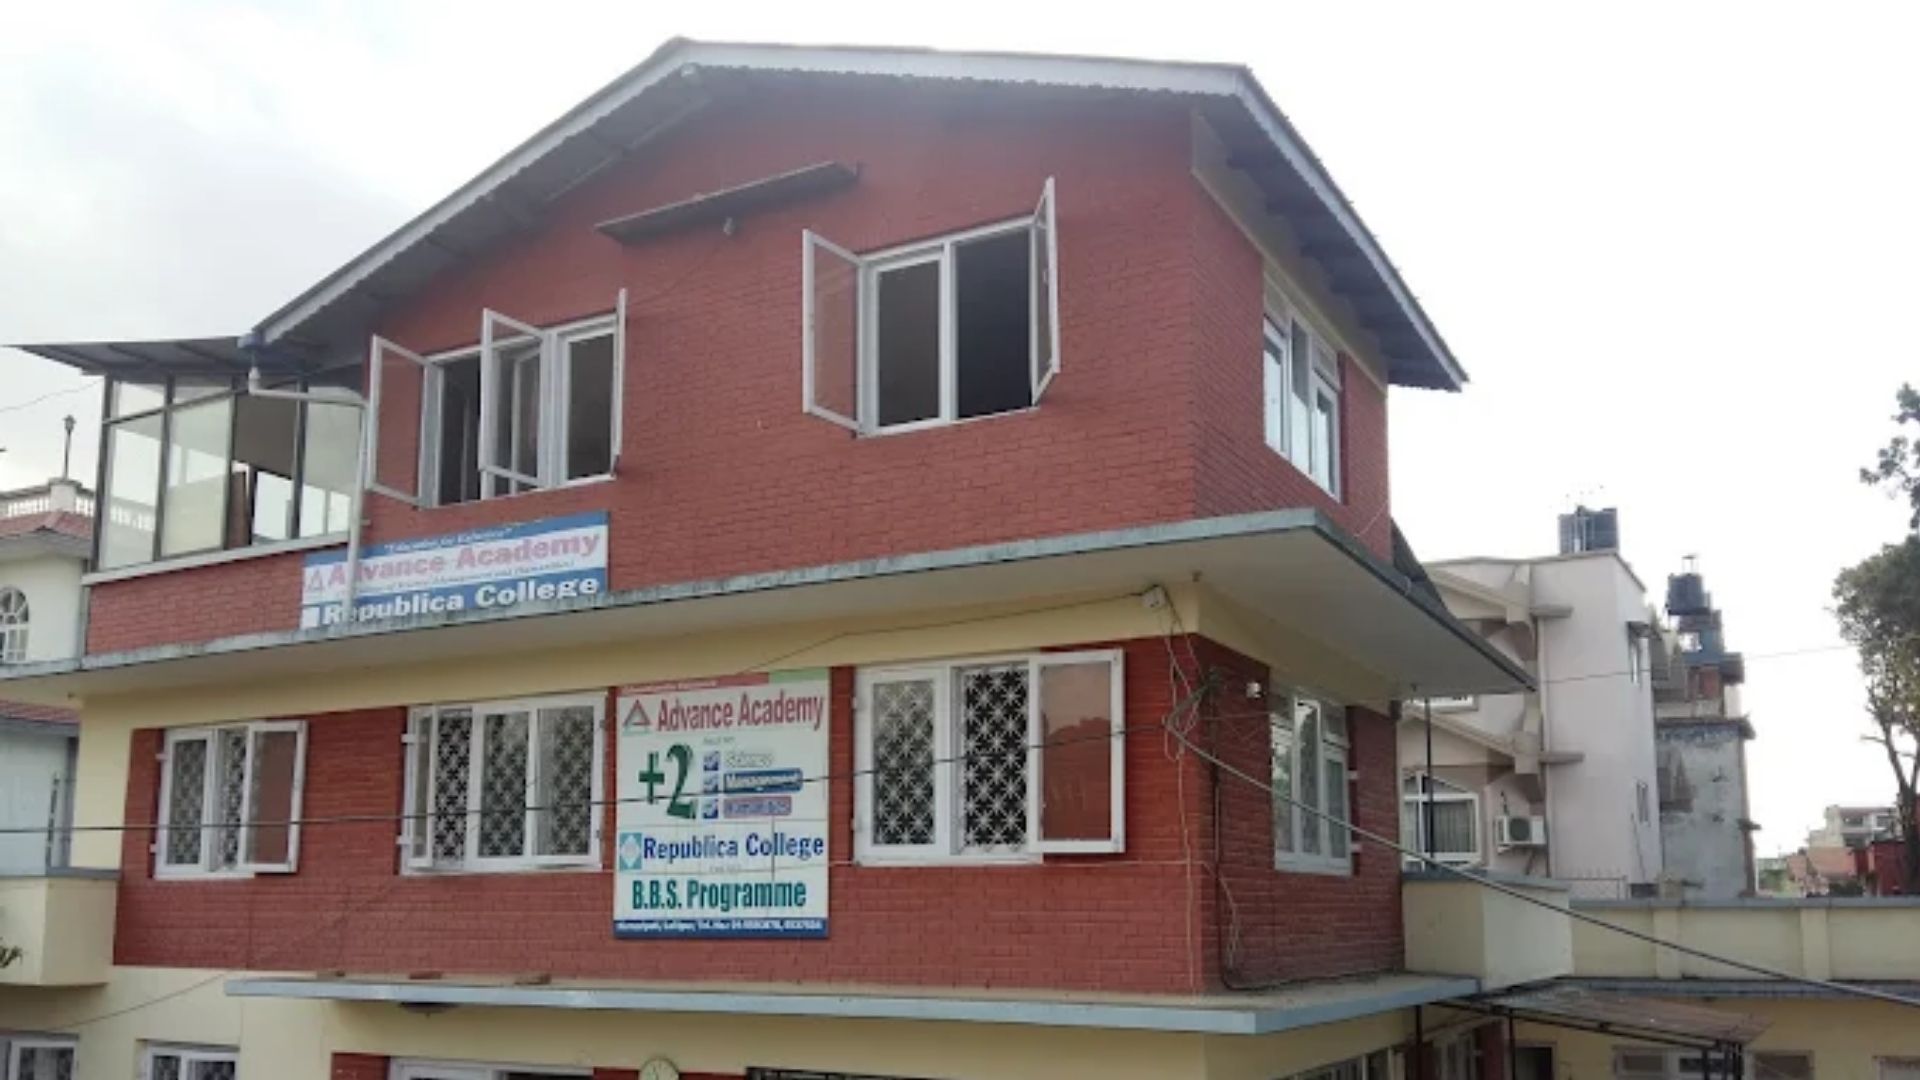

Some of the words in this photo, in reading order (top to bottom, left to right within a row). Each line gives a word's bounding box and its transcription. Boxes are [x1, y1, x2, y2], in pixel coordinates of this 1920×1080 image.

[328, 552, 446, 586] Avance
[457, 532, 600, 568] Academy
[475, 576, 599, 604] College
[657, 699, 734, 732] Advance
[737, 690, 824, 731] Academy
[638, 744, 697, 819] +2
[643, 834, 739, 864] Republica
[745, 832, 824, 861] College
[632, 879, 683, 910] B.B.S.
[687, 879, 807, 912] Programme
